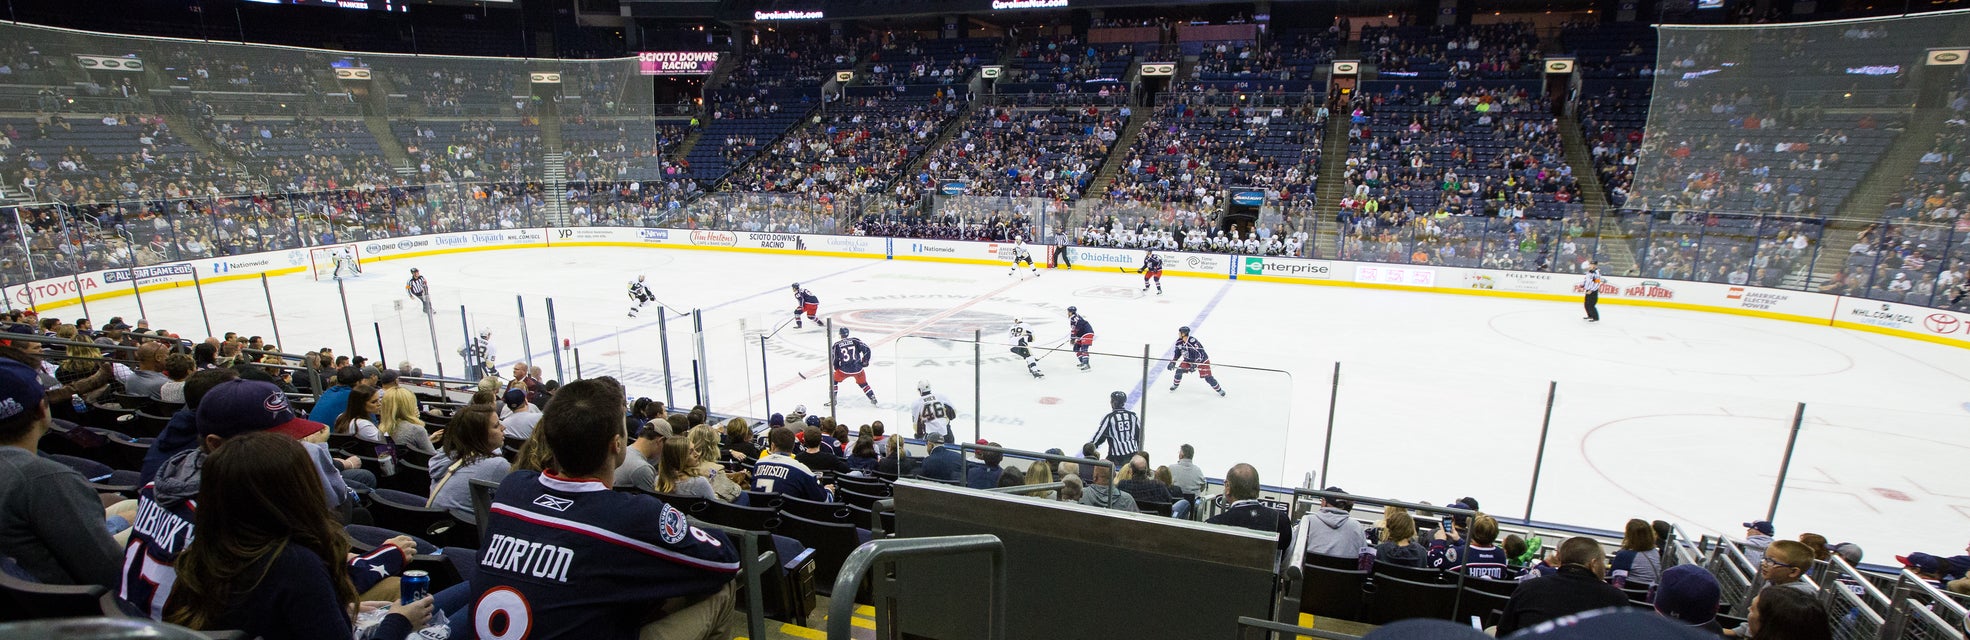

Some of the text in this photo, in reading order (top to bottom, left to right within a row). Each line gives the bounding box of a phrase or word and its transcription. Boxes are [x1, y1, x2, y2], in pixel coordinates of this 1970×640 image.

[639, 52, 719, 62] SCIOTO DOWNS
[661, 62, 698, 70] RACINO
[558, 229, 573, 239] yp
[693, 231, 706, 241] Tim
[749, 233, 796, 242] SCIOTO DOWNS
[761, 241, 785, 249] RACINO
[923, 245, 955, 253] Nationwide
[1081, 252, 1133, 264] OhioHealth
[229, 259, 269, 269] Nationwide
[1250, 259, 1329, 275] enterprise
[150, 267, 174, 277] GAME
[1625, 285, 1673, 299] PAPA JOHNS
[1745, 291, 1789, 302] AMERICAN
[841, 346, 857, 362] 37
[921, 402, 945, 421] 46
[1117, 421, 1131, 432] 83
[754, 464, 789, 480] JOHNSON
[481, 533, 575, 583] HORTON
[1433, 557, 1443, 567] 8
[118, 537, 179, 623] 17
